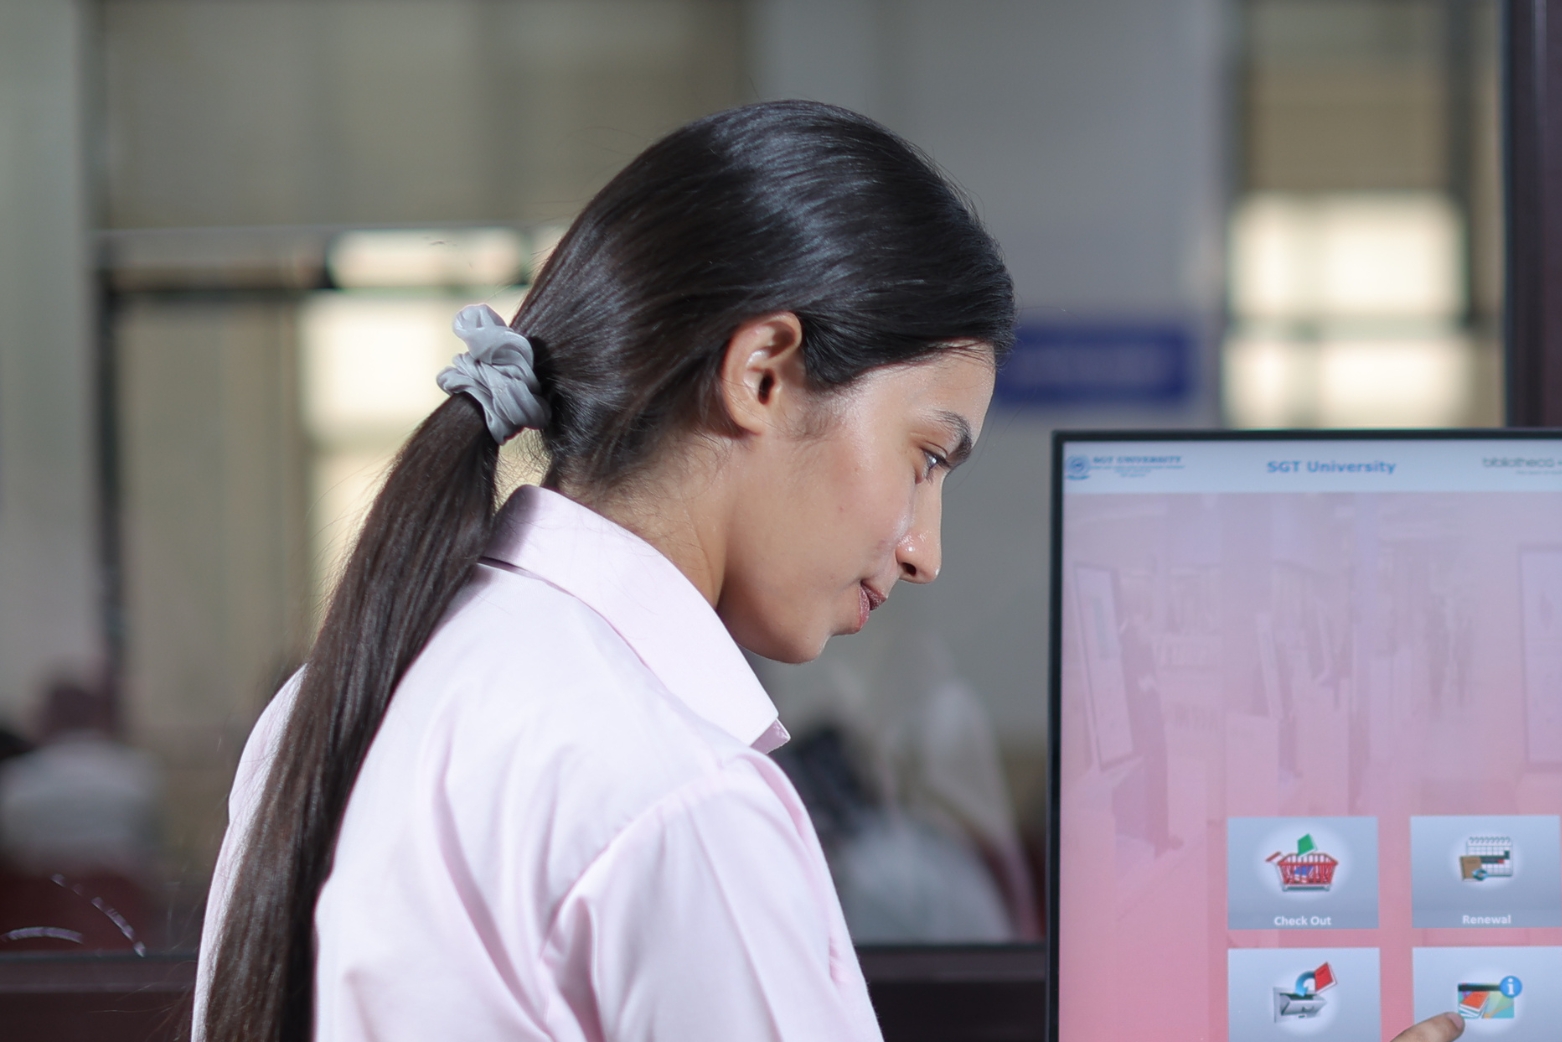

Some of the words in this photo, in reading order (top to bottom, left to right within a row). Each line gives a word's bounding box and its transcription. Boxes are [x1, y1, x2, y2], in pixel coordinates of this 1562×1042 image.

[1267, 460, 1300, 473] SGT
[1307, 459, 1396, 475] University
[1274, 915, 1308, 926] Check
[1310, 915, 1332, 926] Out
[1462, 914, 1511, 924] Renewal
